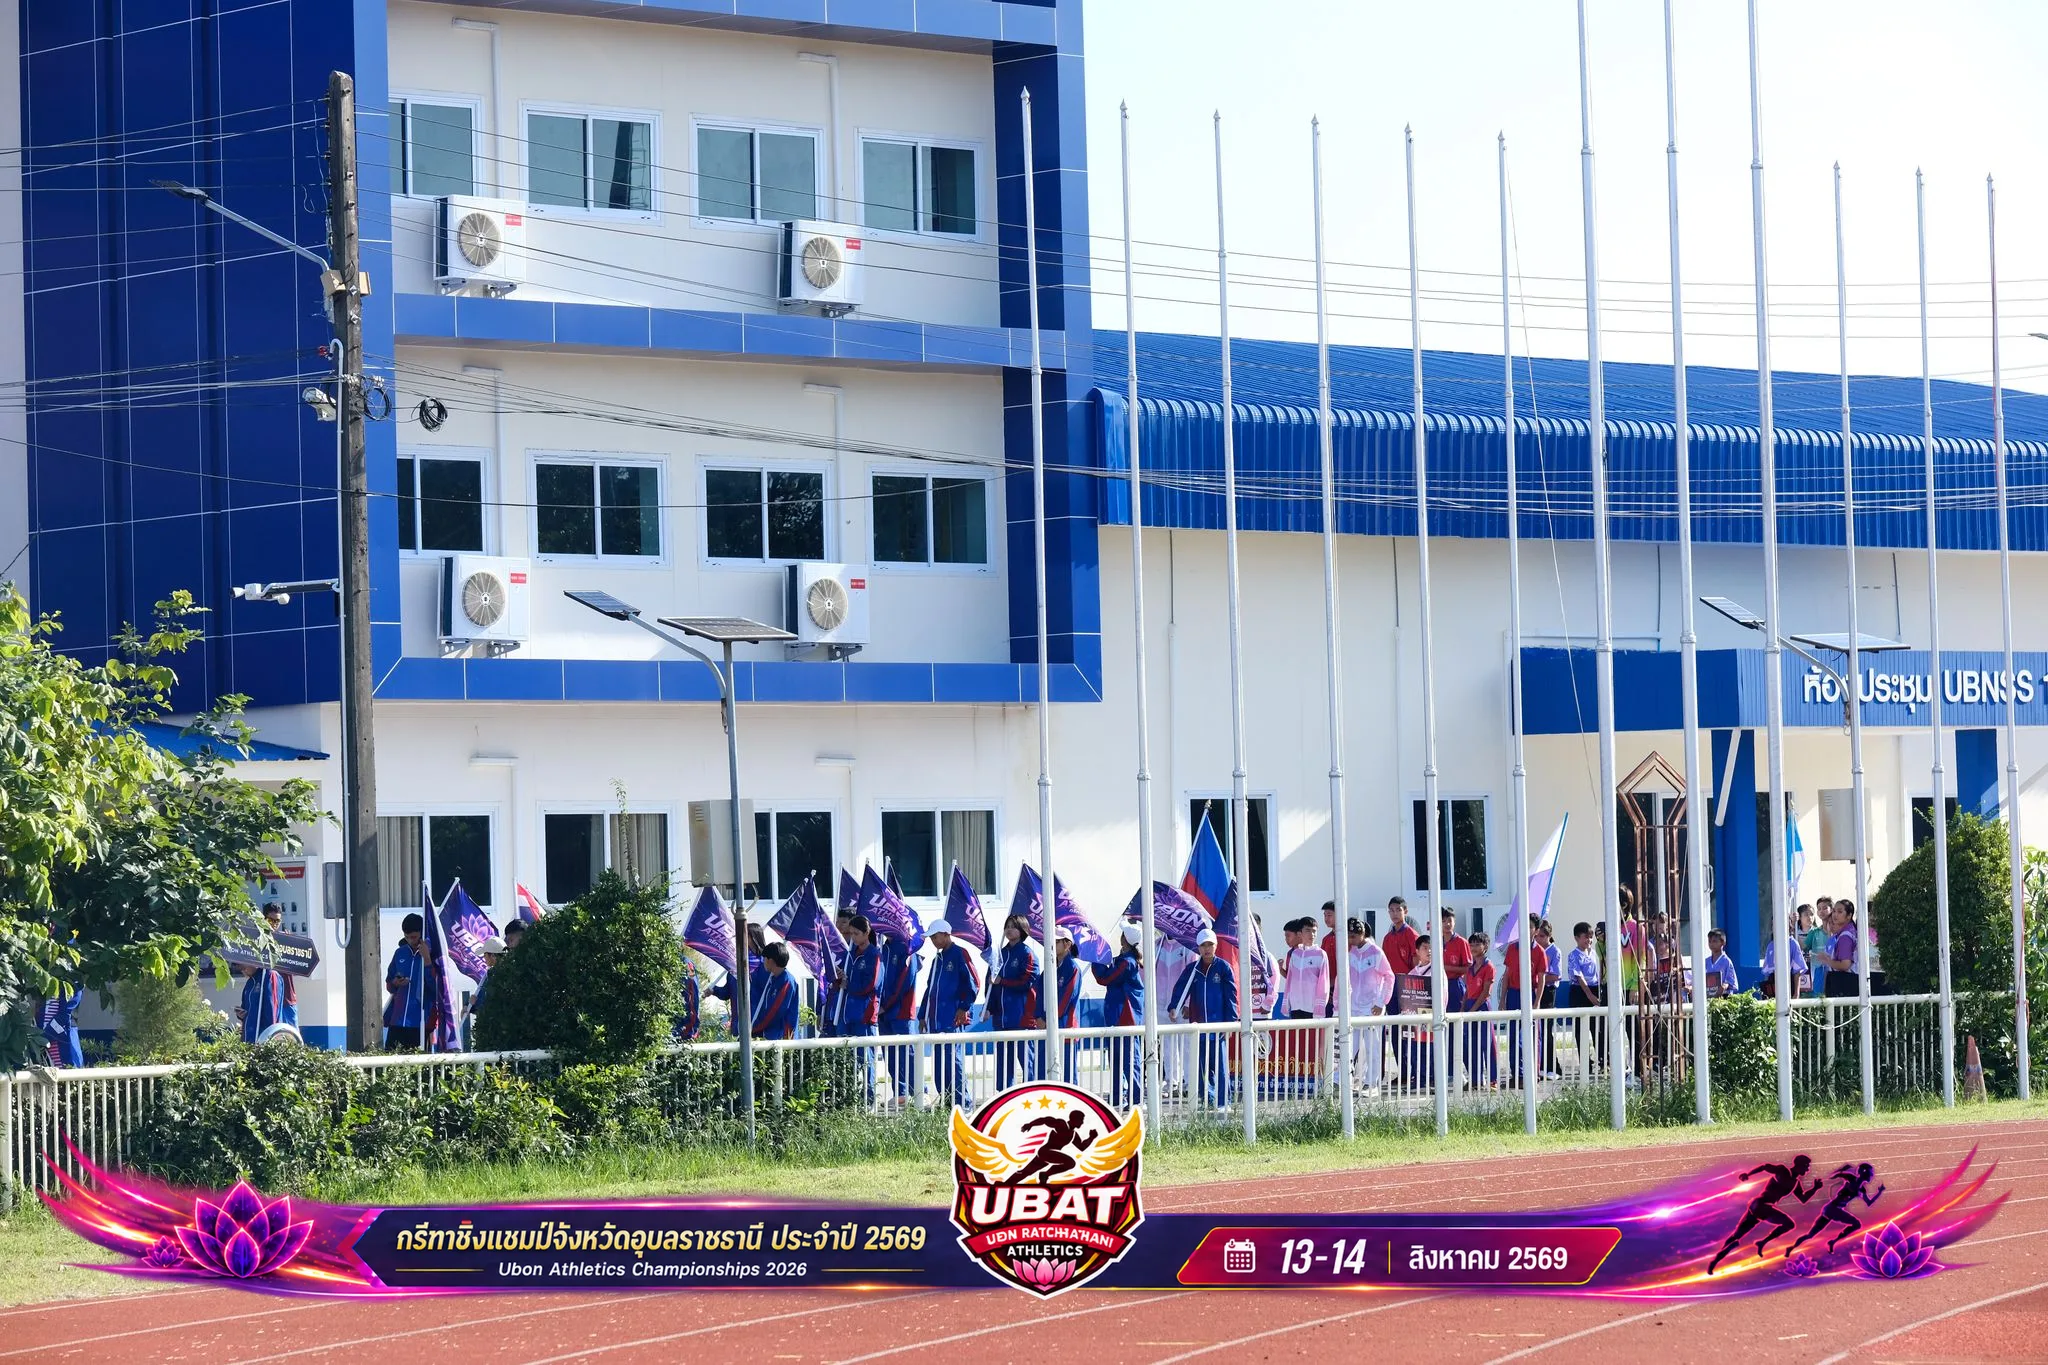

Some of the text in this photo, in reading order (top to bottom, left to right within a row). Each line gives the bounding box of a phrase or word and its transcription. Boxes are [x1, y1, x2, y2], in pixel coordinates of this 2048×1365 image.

[1804, 665, 1933, 713] ห้อประชุม
[1944, 669, 2034, 703] UBNSS
